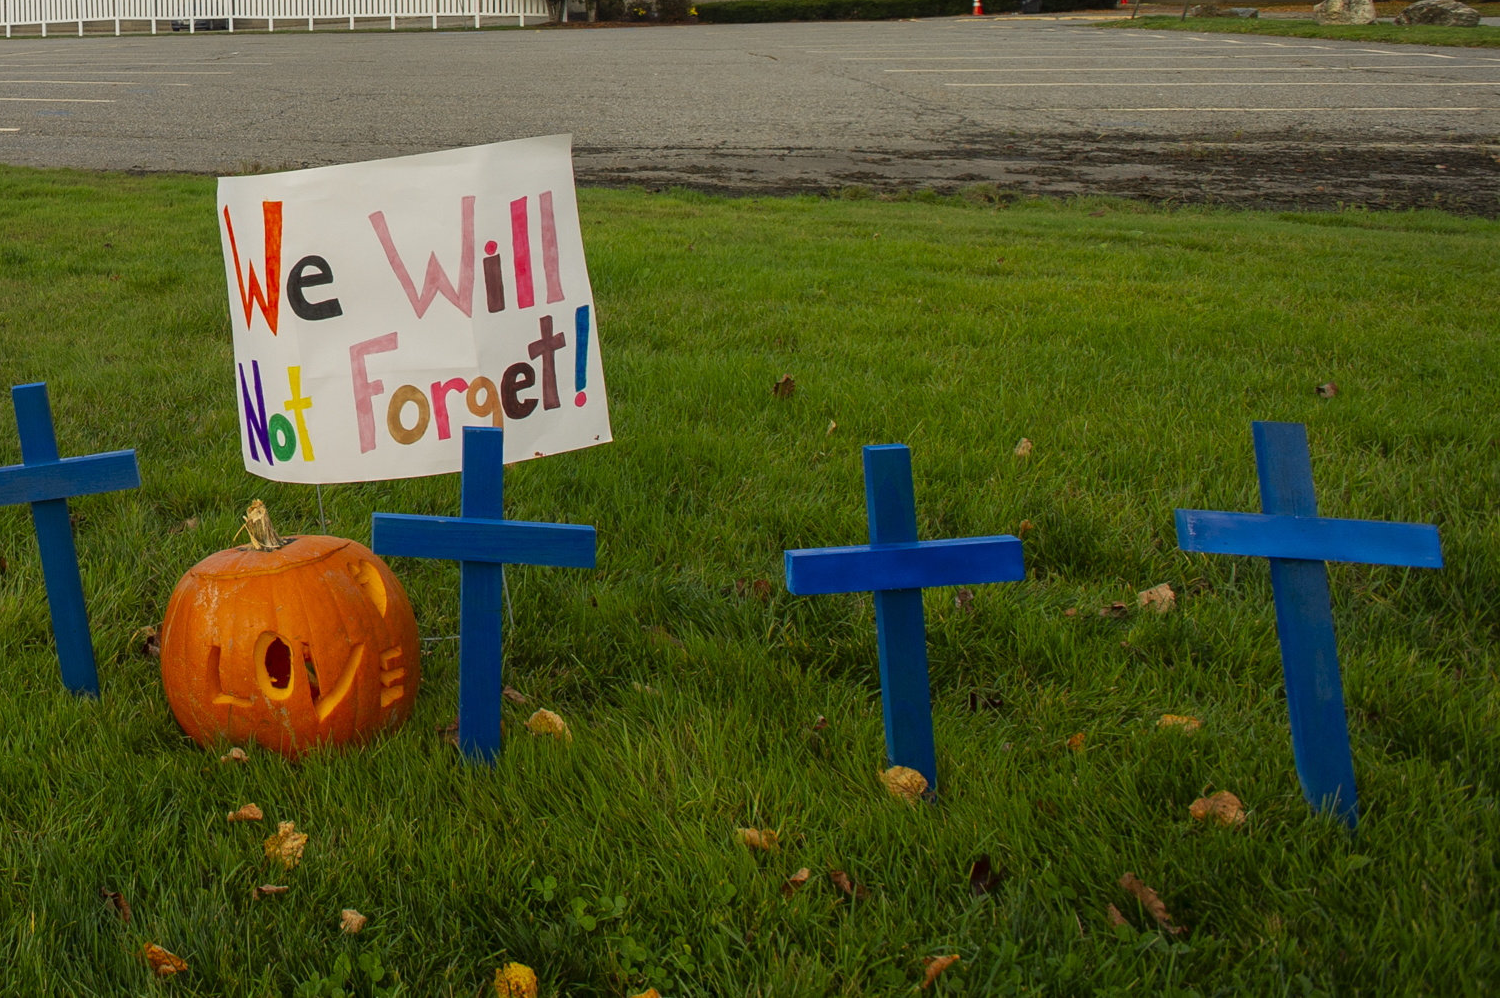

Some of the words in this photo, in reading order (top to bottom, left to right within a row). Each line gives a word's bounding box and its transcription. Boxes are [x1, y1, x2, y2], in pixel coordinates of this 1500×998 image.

[223, 200, 344, 337] We
[367, 190, 566, 319] Will
[238, 359, 315, 466] Not
[349, 304, 590, 454] Forget!
